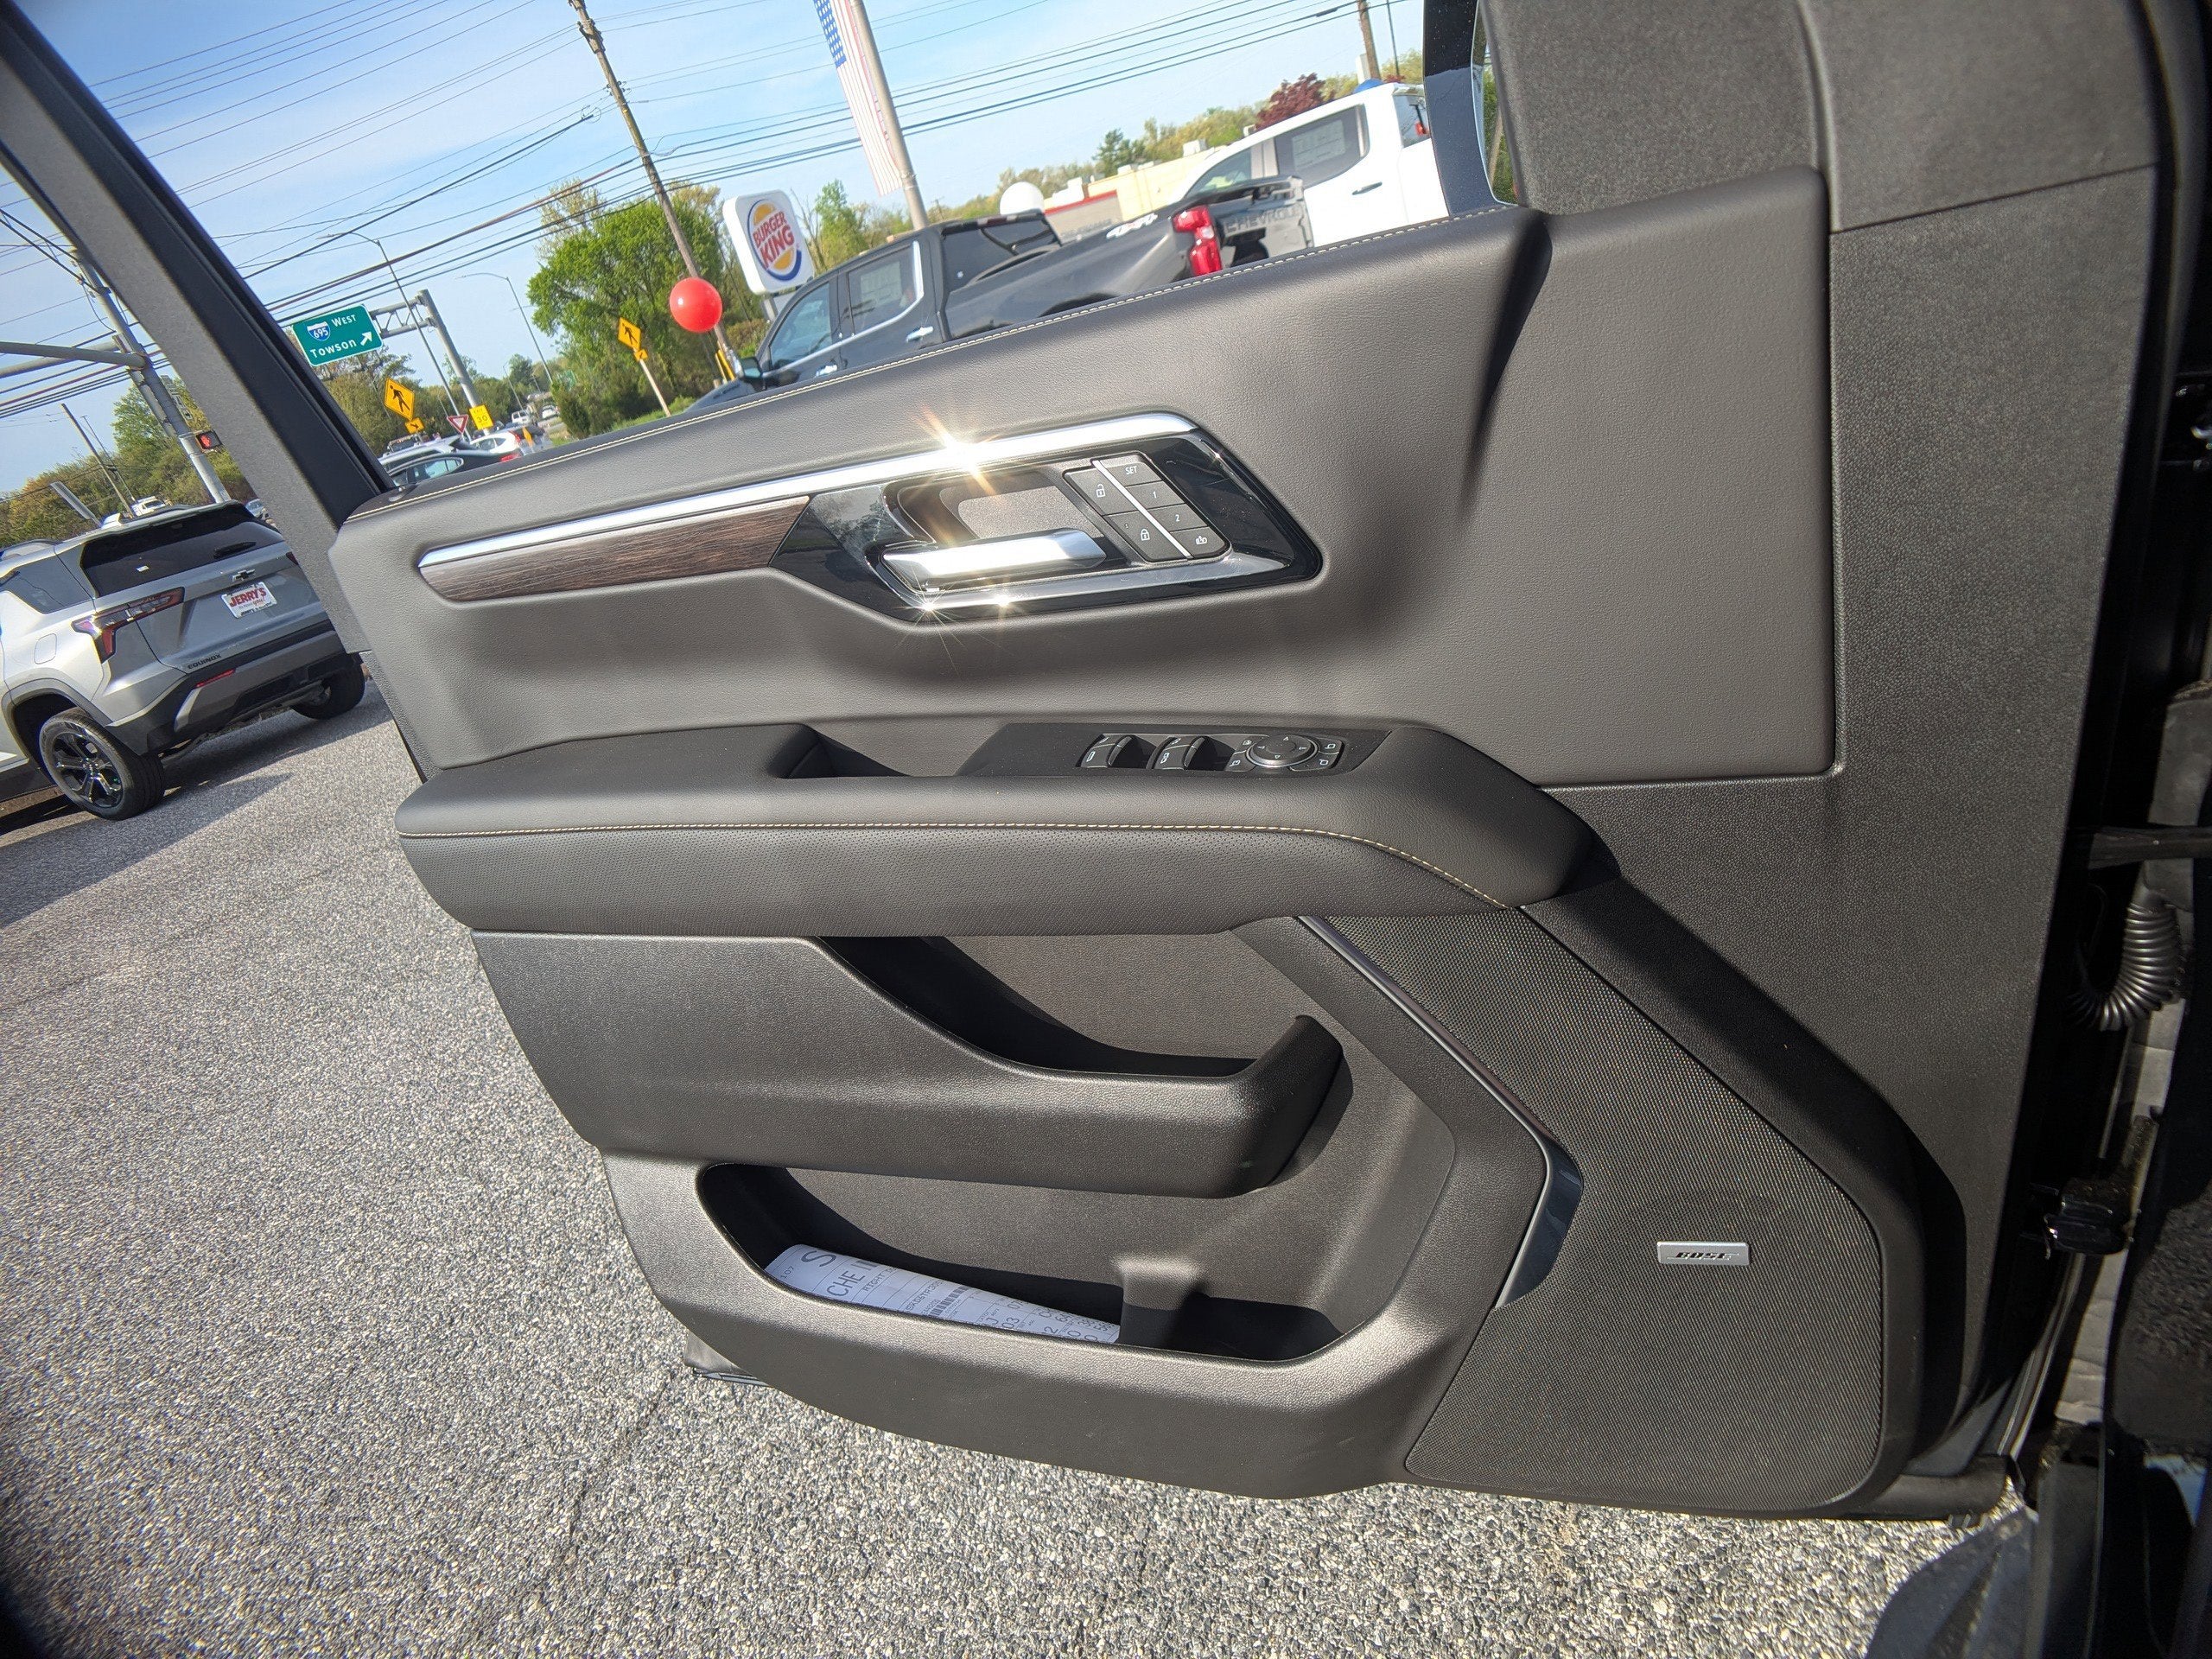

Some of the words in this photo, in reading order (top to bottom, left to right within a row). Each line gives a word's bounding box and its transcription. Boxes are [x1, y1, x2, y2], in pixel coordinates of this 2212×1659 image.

[753, 211, 787, 249] BURGER
[760, 225, 795, 269] KING
[313, 327, 329, 339] 695
[331, 314, 357, 327] WEST
[310, 339, 357, 359] Towson
[476, 415, 488, 423] 30
[1125, 466, 1137, 474] SET
[229, 588, 266, 607] JERRY'S
[188, 653, 221, 669] EQUINOX
[780, 1265, 795, 1280] 107
